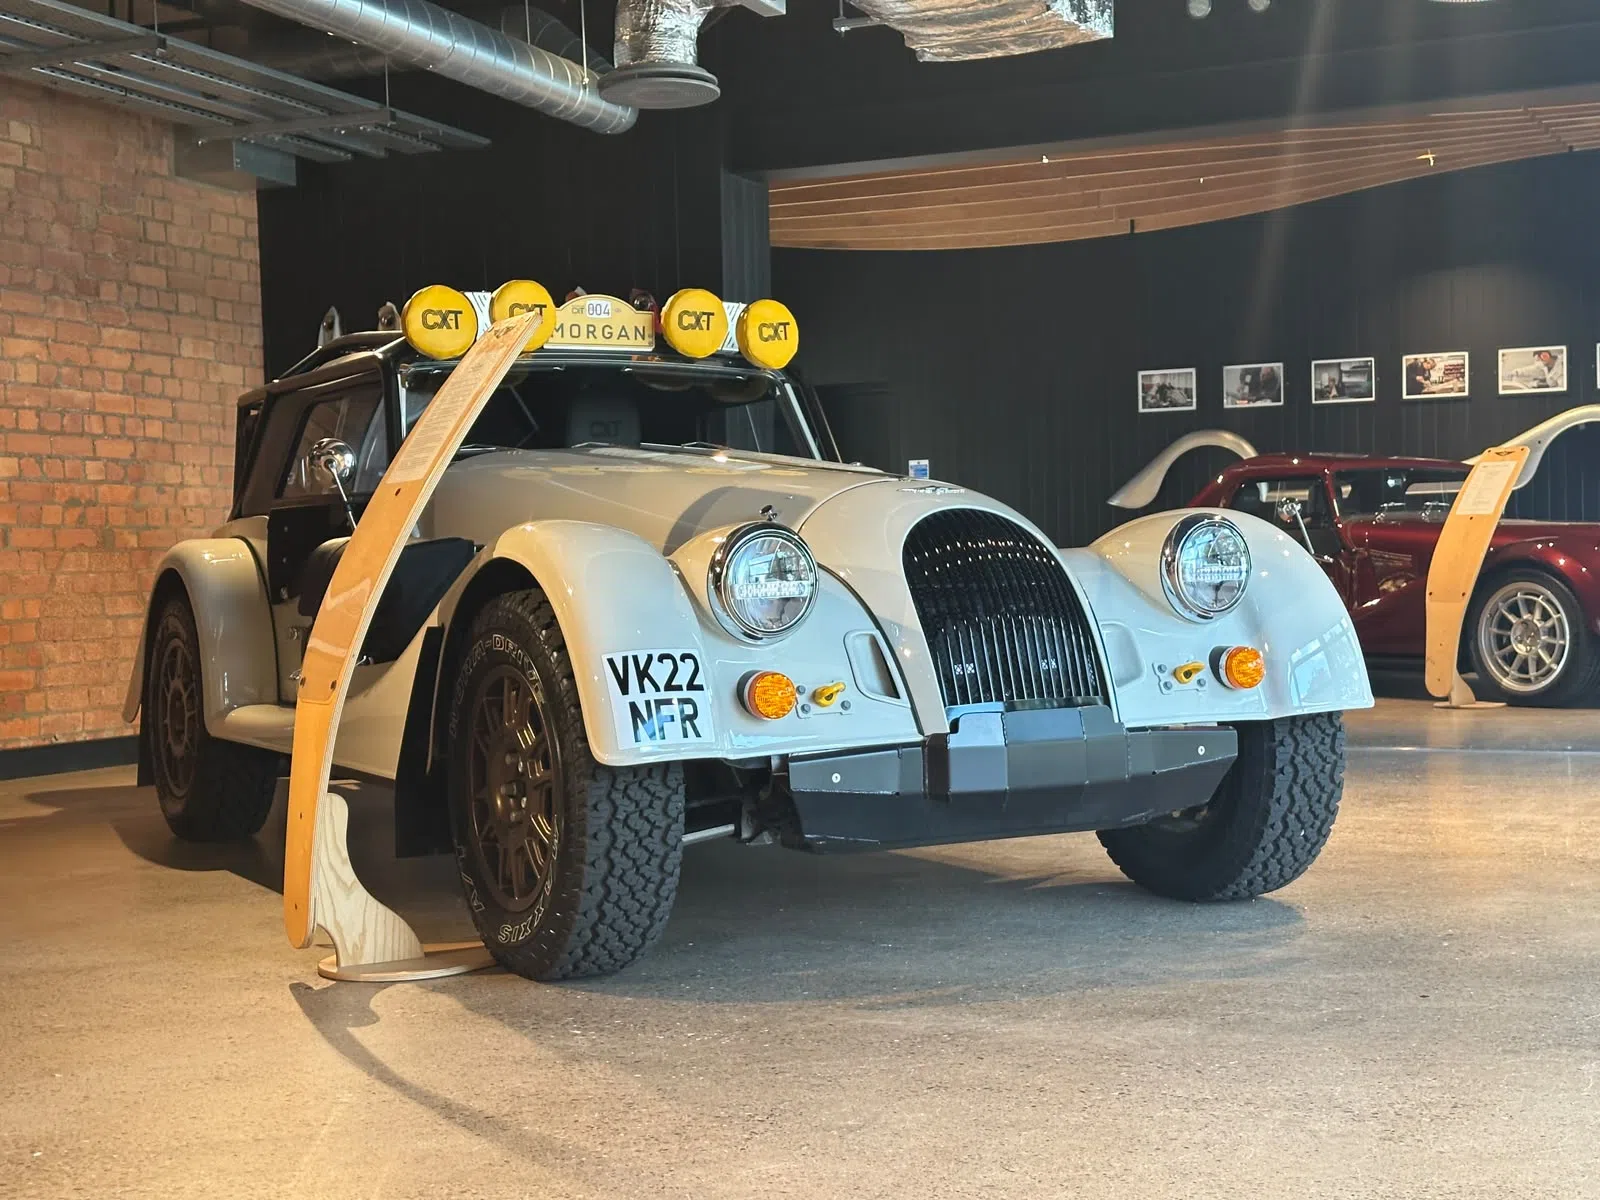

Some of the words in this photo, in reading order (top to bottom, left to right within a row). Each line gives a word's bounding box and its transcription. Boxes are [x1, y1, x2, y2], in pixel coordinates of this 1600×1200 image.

[587, 303, 610, 316] 004
[551, 323, 646, 341] MORGAN
[606, 652, 705, 697] VK22
[628, 697, 703, 743] NFR
